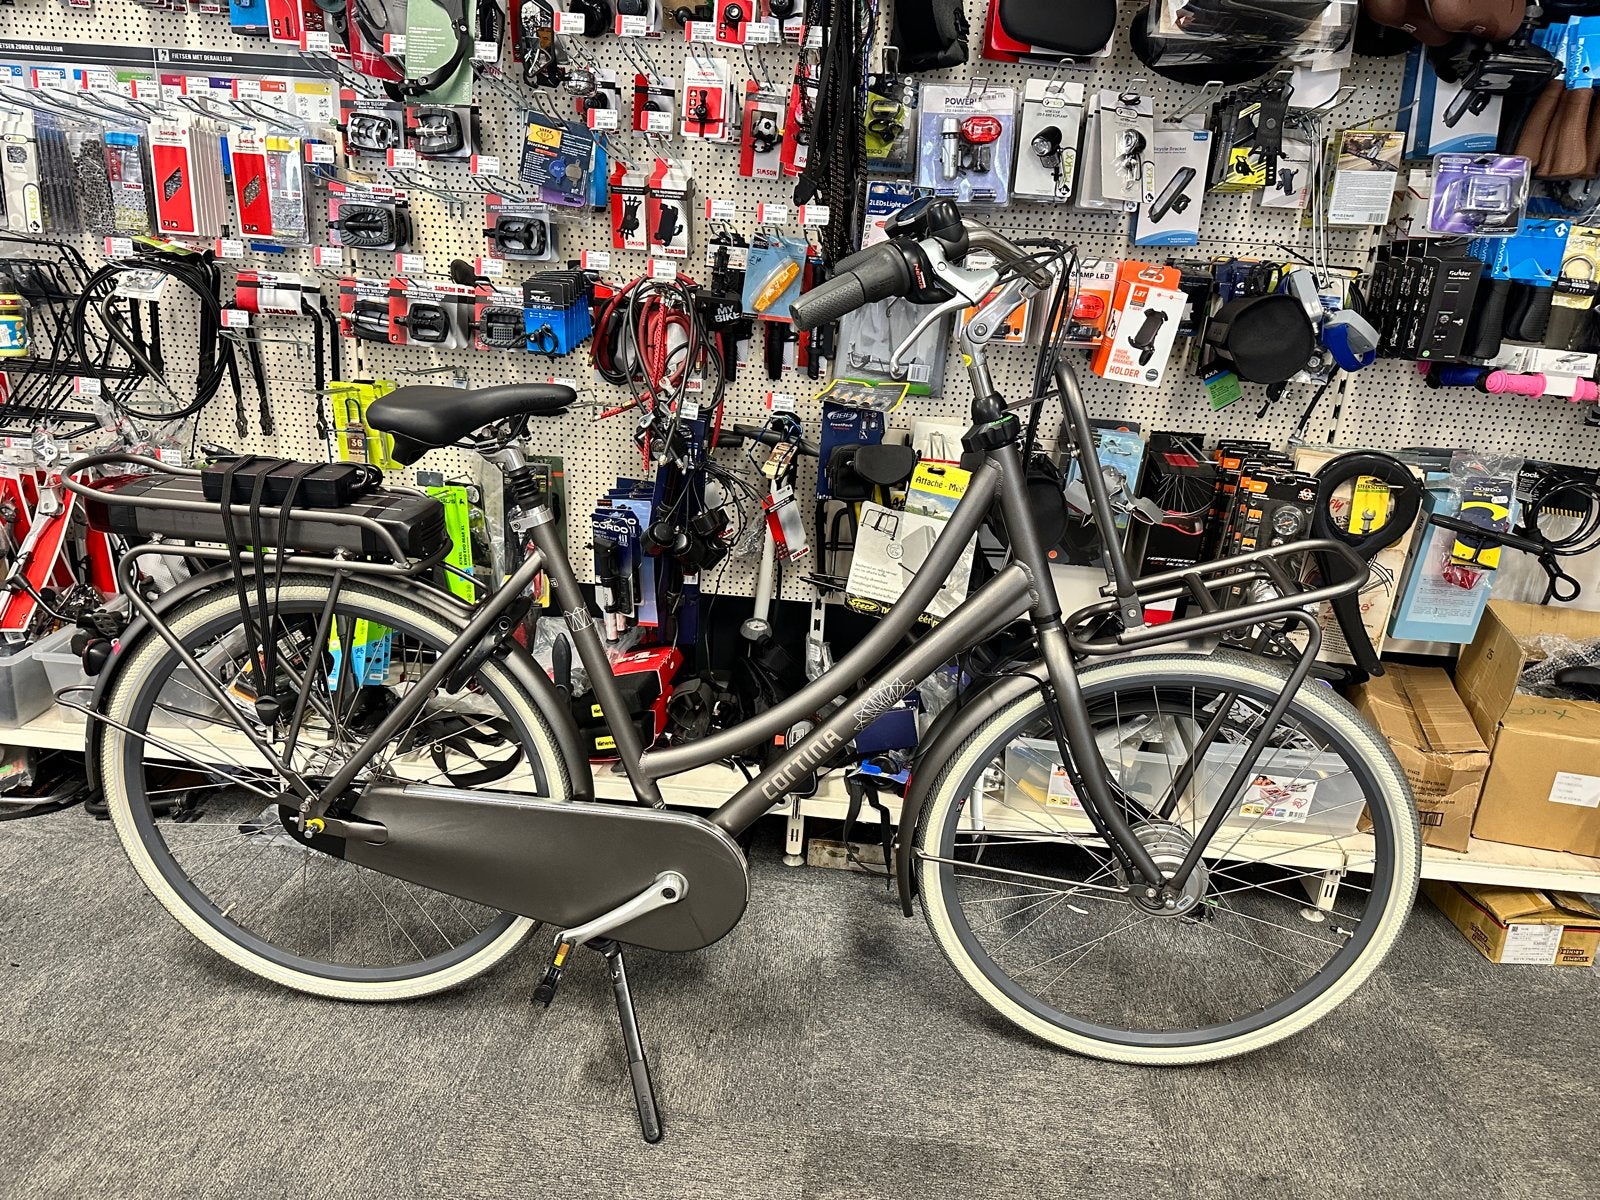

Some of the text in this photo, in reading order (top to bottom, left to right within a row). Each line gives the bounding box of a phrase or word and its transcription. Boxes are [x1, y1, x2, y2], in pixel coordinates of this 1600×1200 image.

[172, 52, 192, 60] FIETSEN
[204, 54, 232, 62] DERAILLEUR
[756, 168, 777, 176] SIMSON
[886, 200, 901, 209] Light
[1494, 238, 1508, 275] M-WAVE
[1098, 272, 1110, 280] LED
[264, 308, 298, 316] SIMSON
[717, 304, 734, 316] MY
[714, 312, 740, 322] BIKE
[1108, 365, 1140, 378] HOLDER
[1204, 370, 1218, 380] AXA
[1520, 470, 1540, 478] Lock
[916, 476, 943, 488] Attaché
[592, 520, 628, 534] CORDO
[849, 598, 877, 610] Steco
[762, 728, 843, 800] CORTINA
